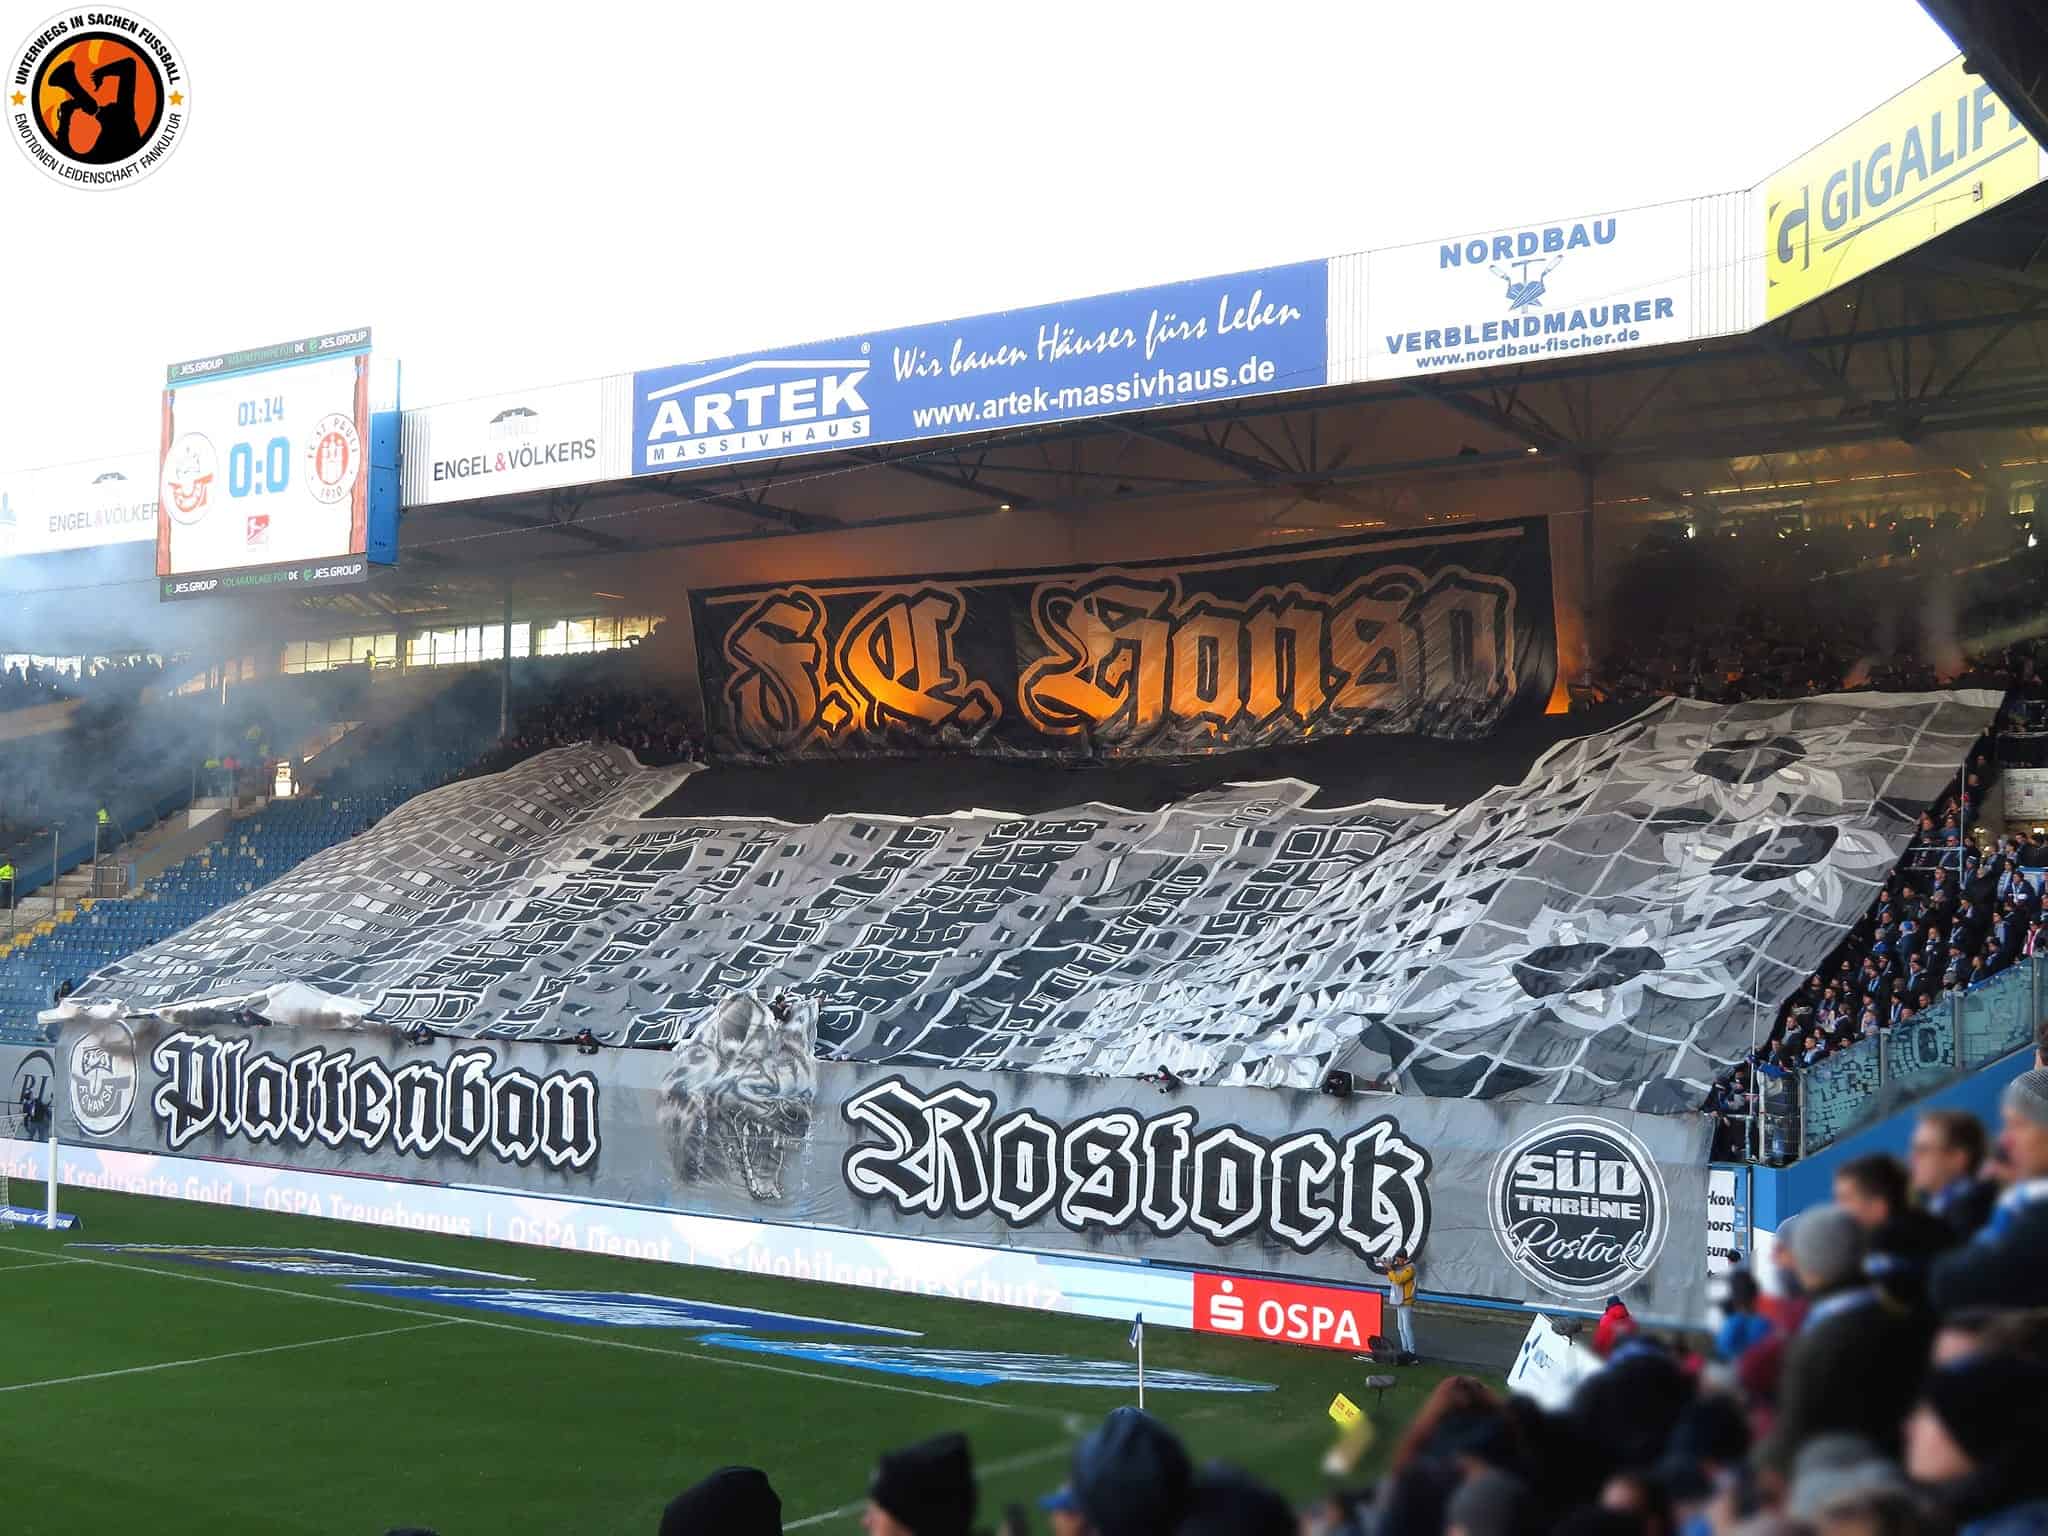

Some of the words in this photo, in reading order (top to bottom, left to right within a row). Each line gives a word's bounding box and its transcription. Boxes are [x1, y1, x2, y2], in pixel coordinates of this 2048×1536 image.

[1439, 218, 1617, 268] NORDBAU
[894, 346, 943, 383] Wir
[950, 338, 1028, 377] bauen
[1038, 322, 1137, 364] Häuser
[1145, 309, 1207, 360] fürs
[1218, 289, 1302, 336] Leben
[1386, 297, 1675, 354] VERBLENDMAURER
[1416, 327, 1640, 368] www.nordbau-fischer.de
[237, 395, 284, 427] 01:14
[647, 369, 870, 441] ARTEK
[912, 355, 1276, 428] www.artek-massivhaus.de
[229, 436, 290, 498] 0:0
[653, 420, 863, 461] MASSIVHAUS
[173, 580, 217, 594] JES.GROUP
[313, 564, 361, 579] JES.GROUP
[151, 1027, 602, 1169] Plattenbau
[841, 1074, 1432, 1272] Rostock
[1514, 1150, 1642, 1197] SÜD
[264, 1186, 322, 1214] OSPA
[508, 1216, 577, 1249] OSPA
[1515, 1194, 1641, 1220] TRIBÜNE
[1507, 1216, 1648, 1273] Rostock
[1258, 1300, 1361, 1346] OSPA
